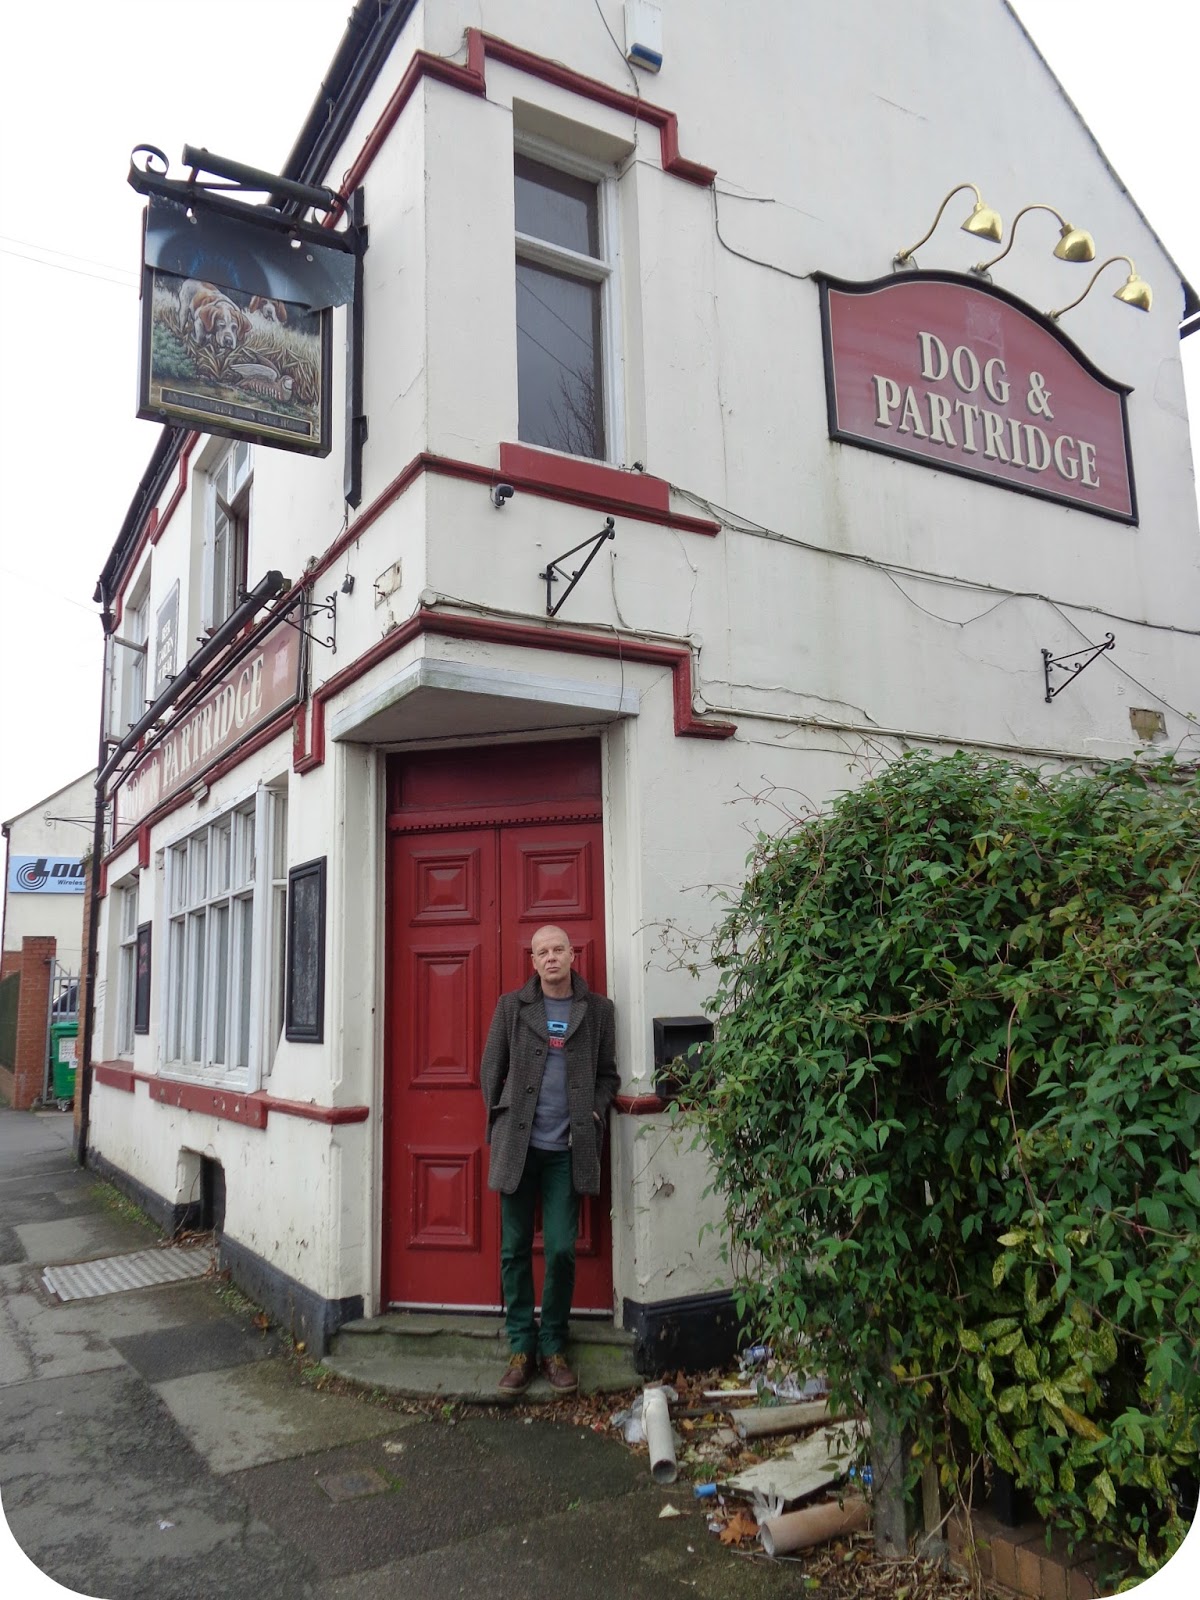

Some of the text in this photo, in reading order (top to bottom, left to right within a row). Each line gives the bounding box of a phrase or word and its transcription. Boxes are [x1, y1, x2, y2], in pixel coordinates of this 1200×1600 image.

[872, 374, 1100, 488] PARTRIDGE
[917, 331, 1055, 420] DOG &
[162, 653, 264, 788] PARTRIDGE
